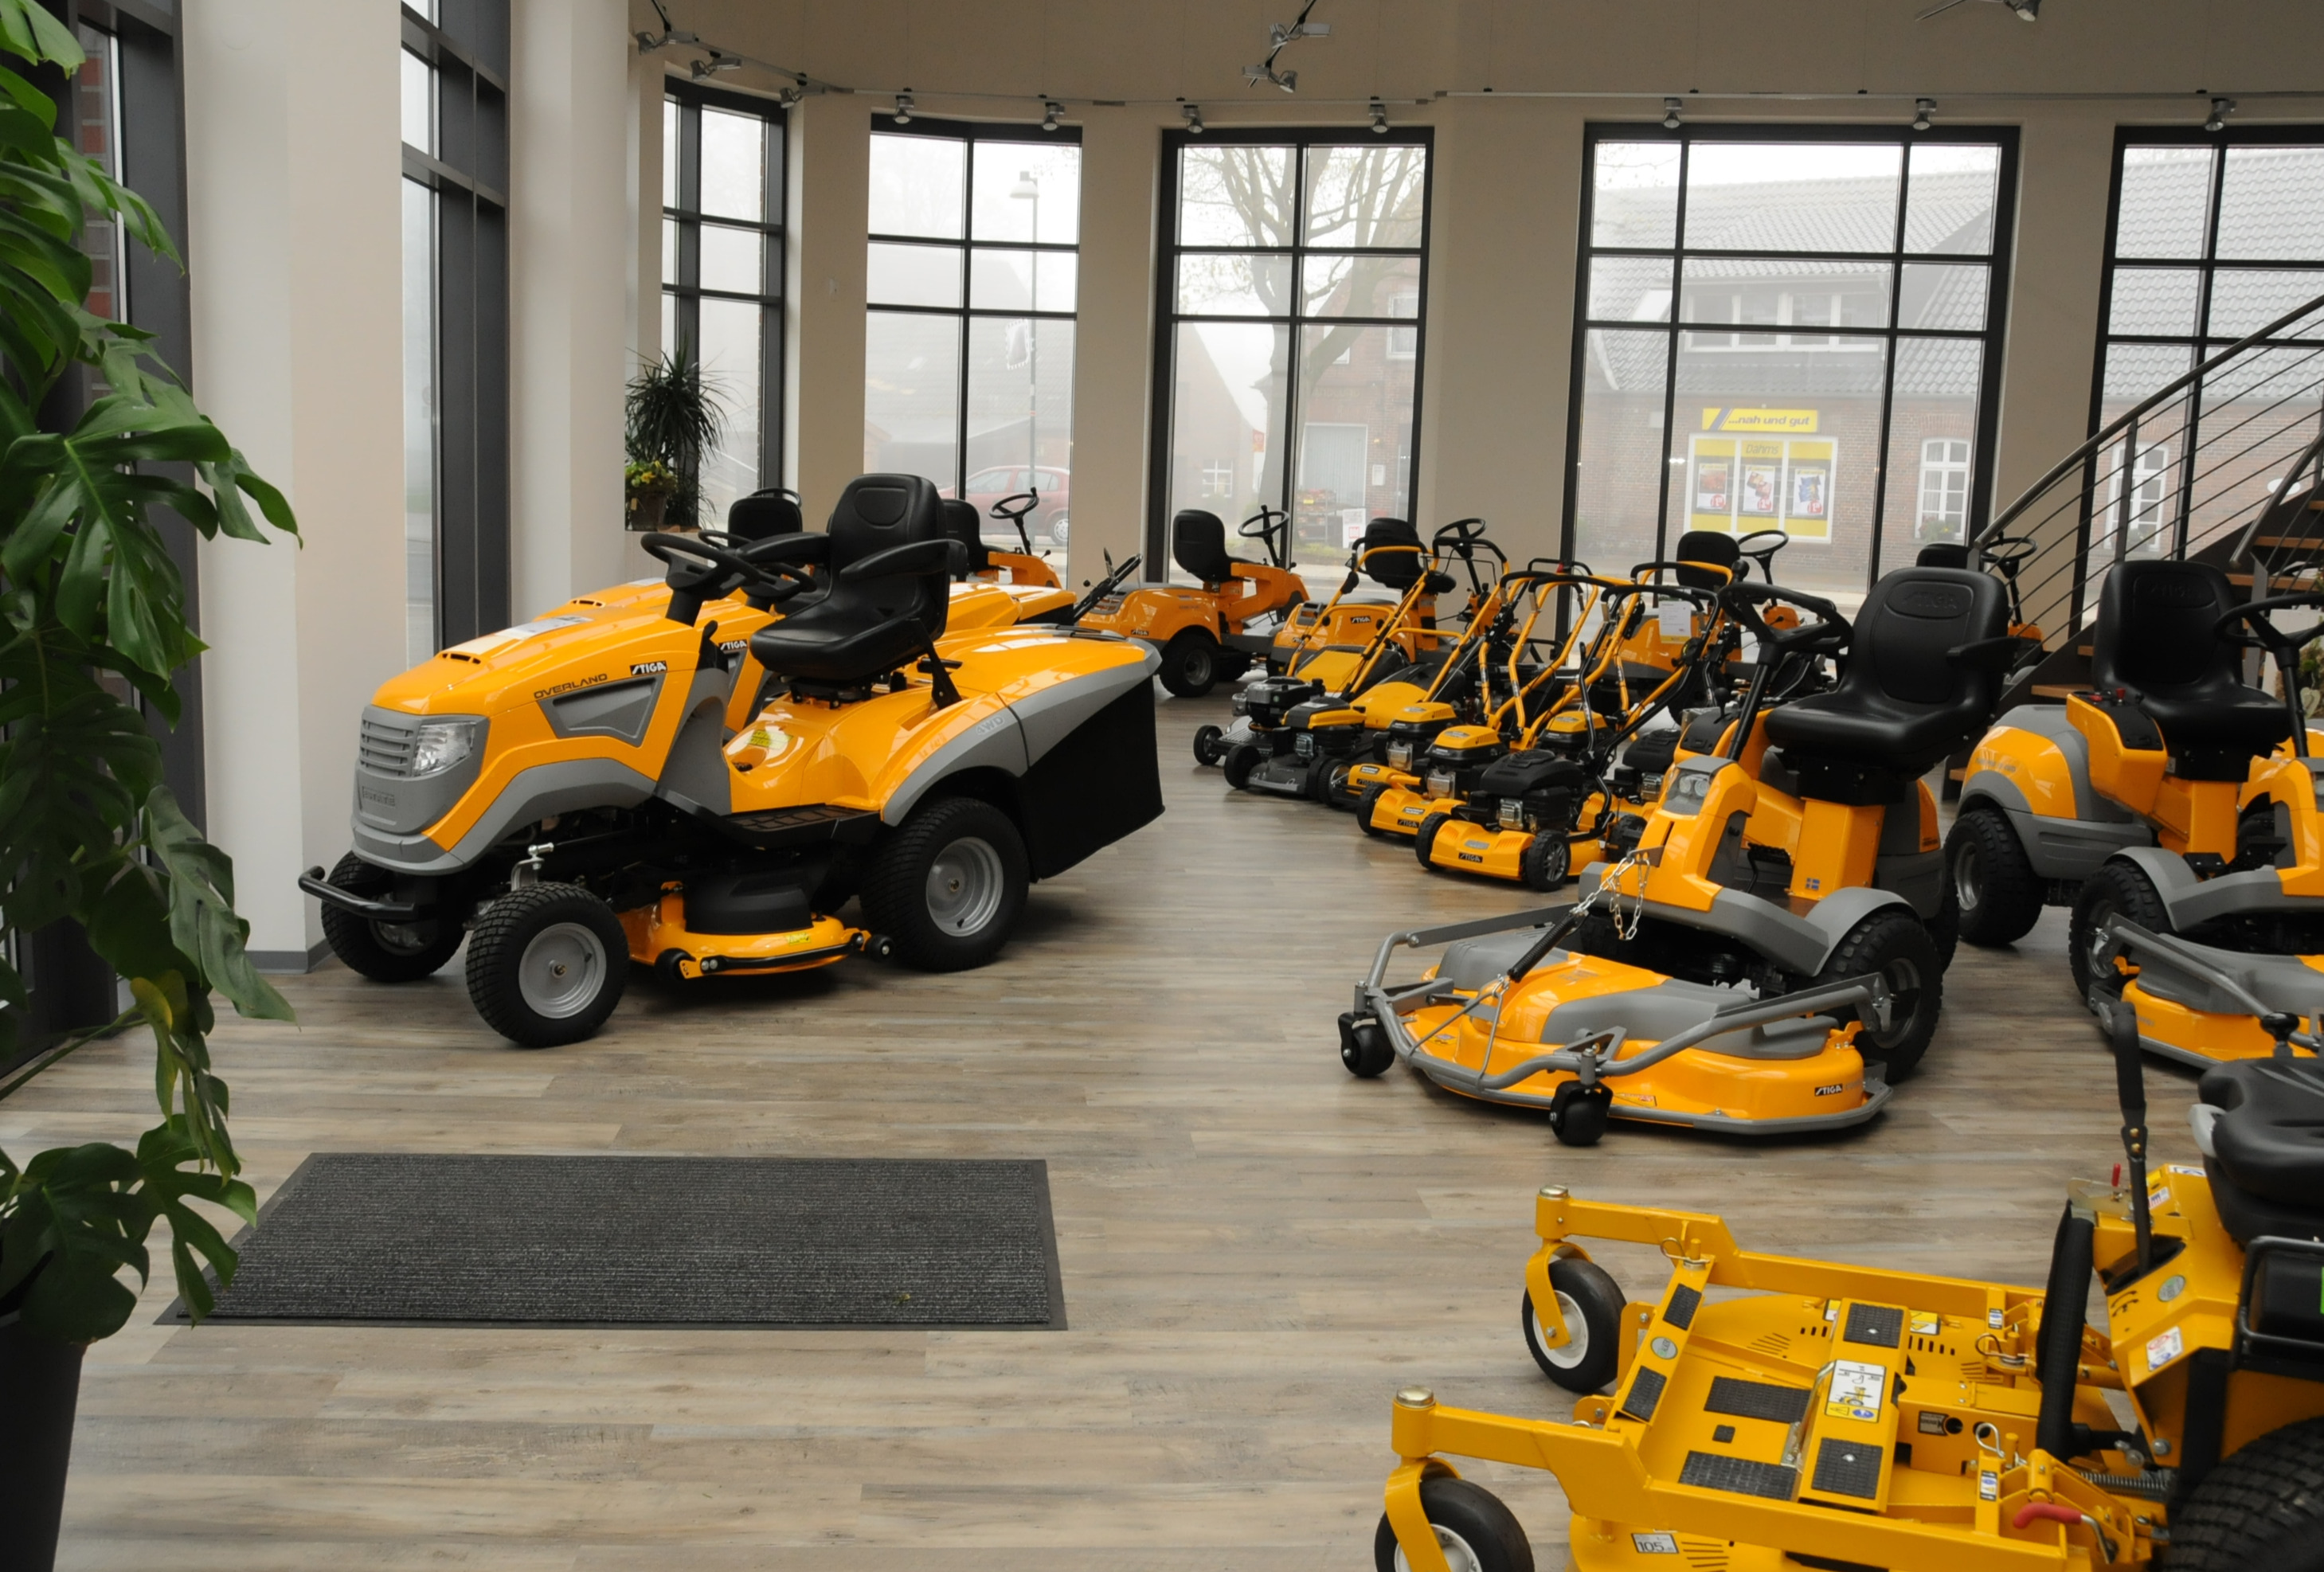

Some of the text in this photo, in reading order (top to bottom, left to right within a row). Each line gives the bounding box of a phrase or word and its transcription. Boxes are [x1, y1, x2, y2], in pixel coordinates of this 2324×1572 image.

[1763, 416, 1787, 425] und
[1789, 416, 1810, 428] gut
[1745, 444, 1779, 455] Dahms
[719, 639, 747, 651] STIGA
[632, 662, 667, 675] STIGA
[533, 673, 608, 699] OVERLAND
[976, 715, 1004, 734] 4WD
[1399, 819, 1418, 828] STIGA
[1460, 852, 1481, 862] STIGA
[1815, 1085, 1842, 1096] STIGA
[1637, 1541, 1665, 1552] 105
